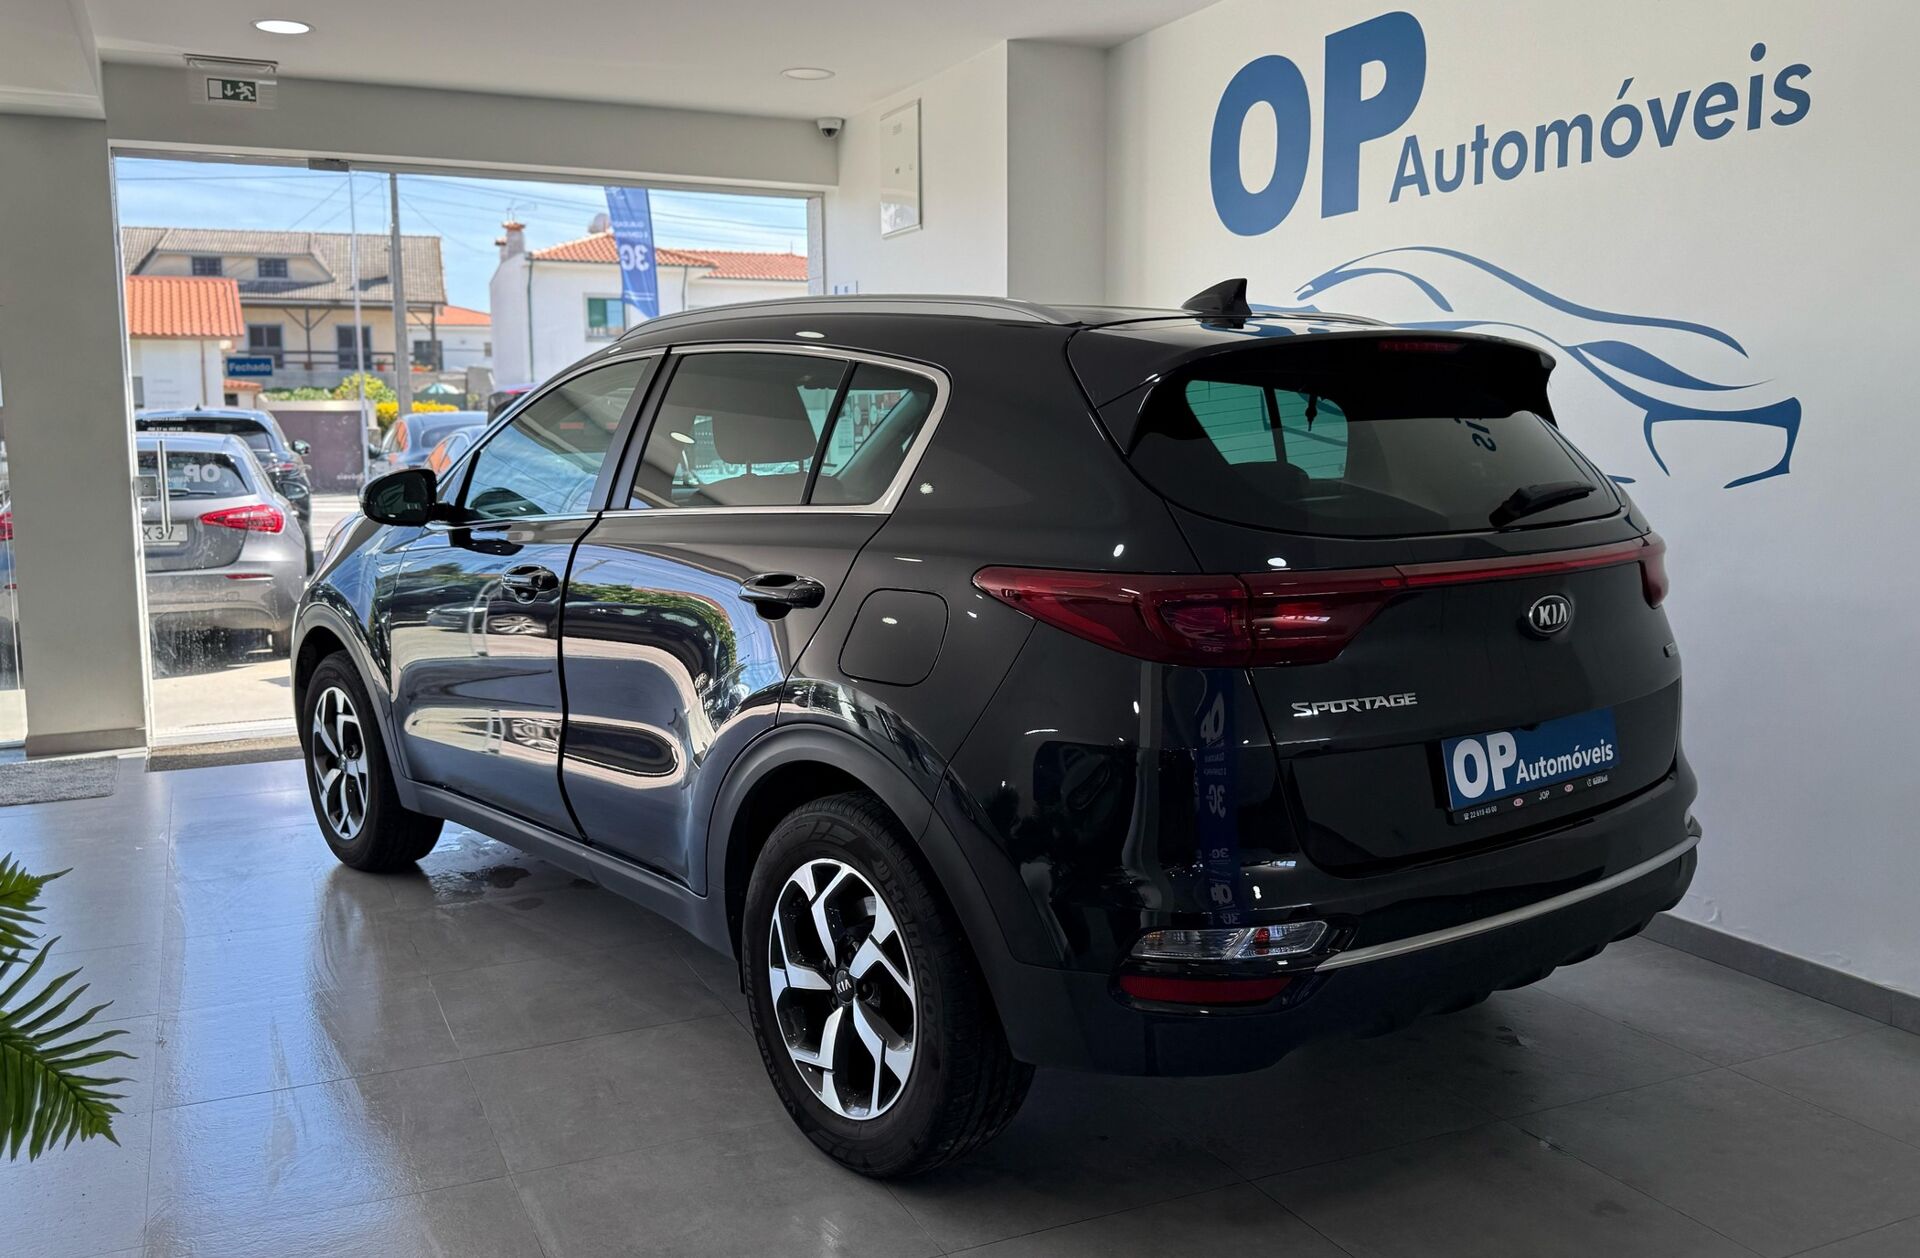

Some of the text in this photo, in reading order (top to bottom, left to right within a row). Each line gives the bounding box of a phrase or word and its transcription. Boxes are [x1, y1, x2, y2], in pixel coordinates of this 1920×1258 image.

[1210, 11, 1813, 237] OP Automóveis
[1538, 602, 1568, 627] KIA
[1291, 692, 1418, 717] SPORTAGE
[1452, 731, 1614, 799] OP Automóveis
[836, 978, 852, 994] KIA
